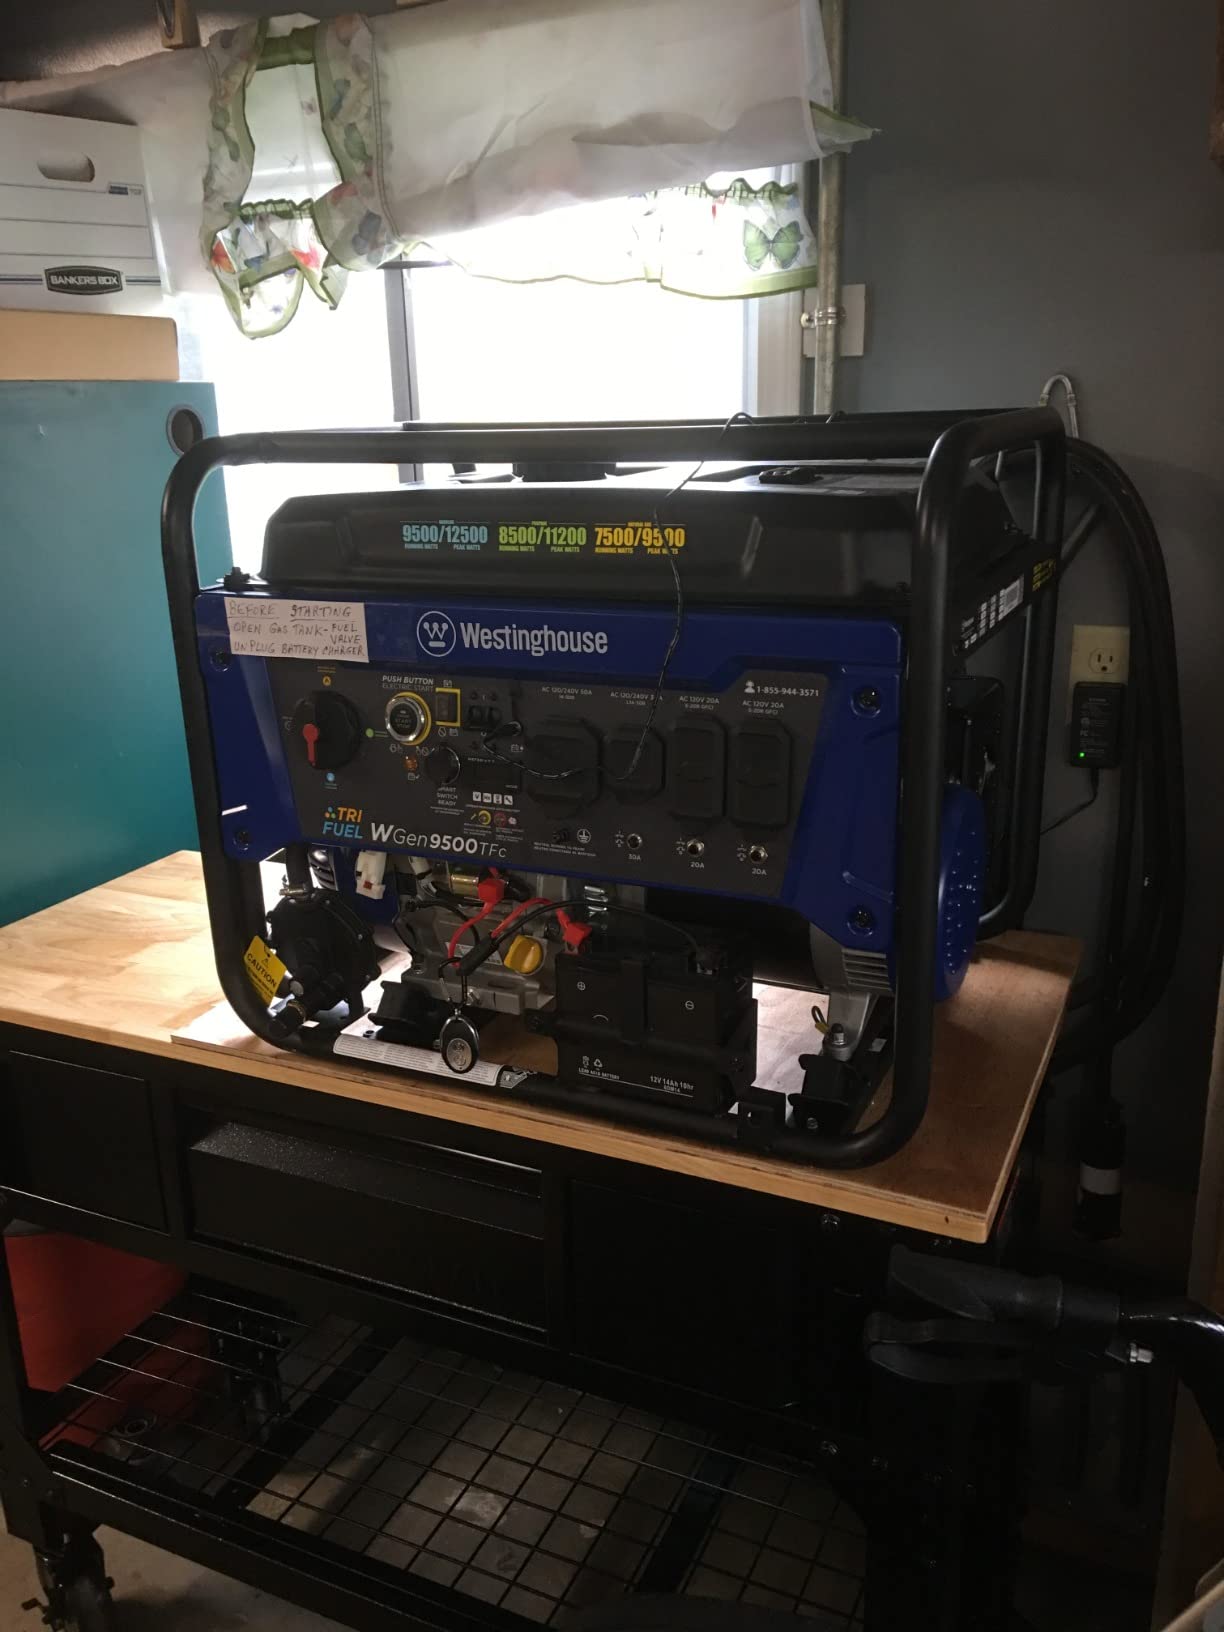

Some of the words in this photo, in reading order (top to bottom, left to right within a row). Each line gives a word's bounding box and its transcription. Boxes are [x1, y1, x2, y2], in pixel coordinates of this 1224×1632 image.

[49, 275, 98, 285] BANKERS
[99, 275, 119, 285] BOX
[402, 524, 488, 544] 9500/12500
[498, 526, 587, 545] 8500/11200
[594, 527, 686, 547] 7500/9500
[228, 600, 276, 616] BEFORE
[290, 604, 353, 618] STARTING
[233, 620, 262, 634] OPEN
[269, 622, 289, 634] GAS
[331, 622, 359, 633] FUEL
[330, 634, 361, 645] VALVE
[460, 622, 609, 657] Westinghouse
[281, 643, 319, 657] BATTERY
[322, 645, 366, 657] CHARGER
[382, 675, 402, 684] PUSH
[404, 676, 434, 686] BUTTON
[757, 685, 819, 697] 1-855-944-3571
[436, 792, 458, 800] SWITCH
[337, 806, 363, 823] TRI
[322, 821, 363, 839] FUEL
[247, 953, 278, 988] CAUTION
[650, 1075, 662, 1084] 12V
[663, 1077, 679, 1087] 14Ah
